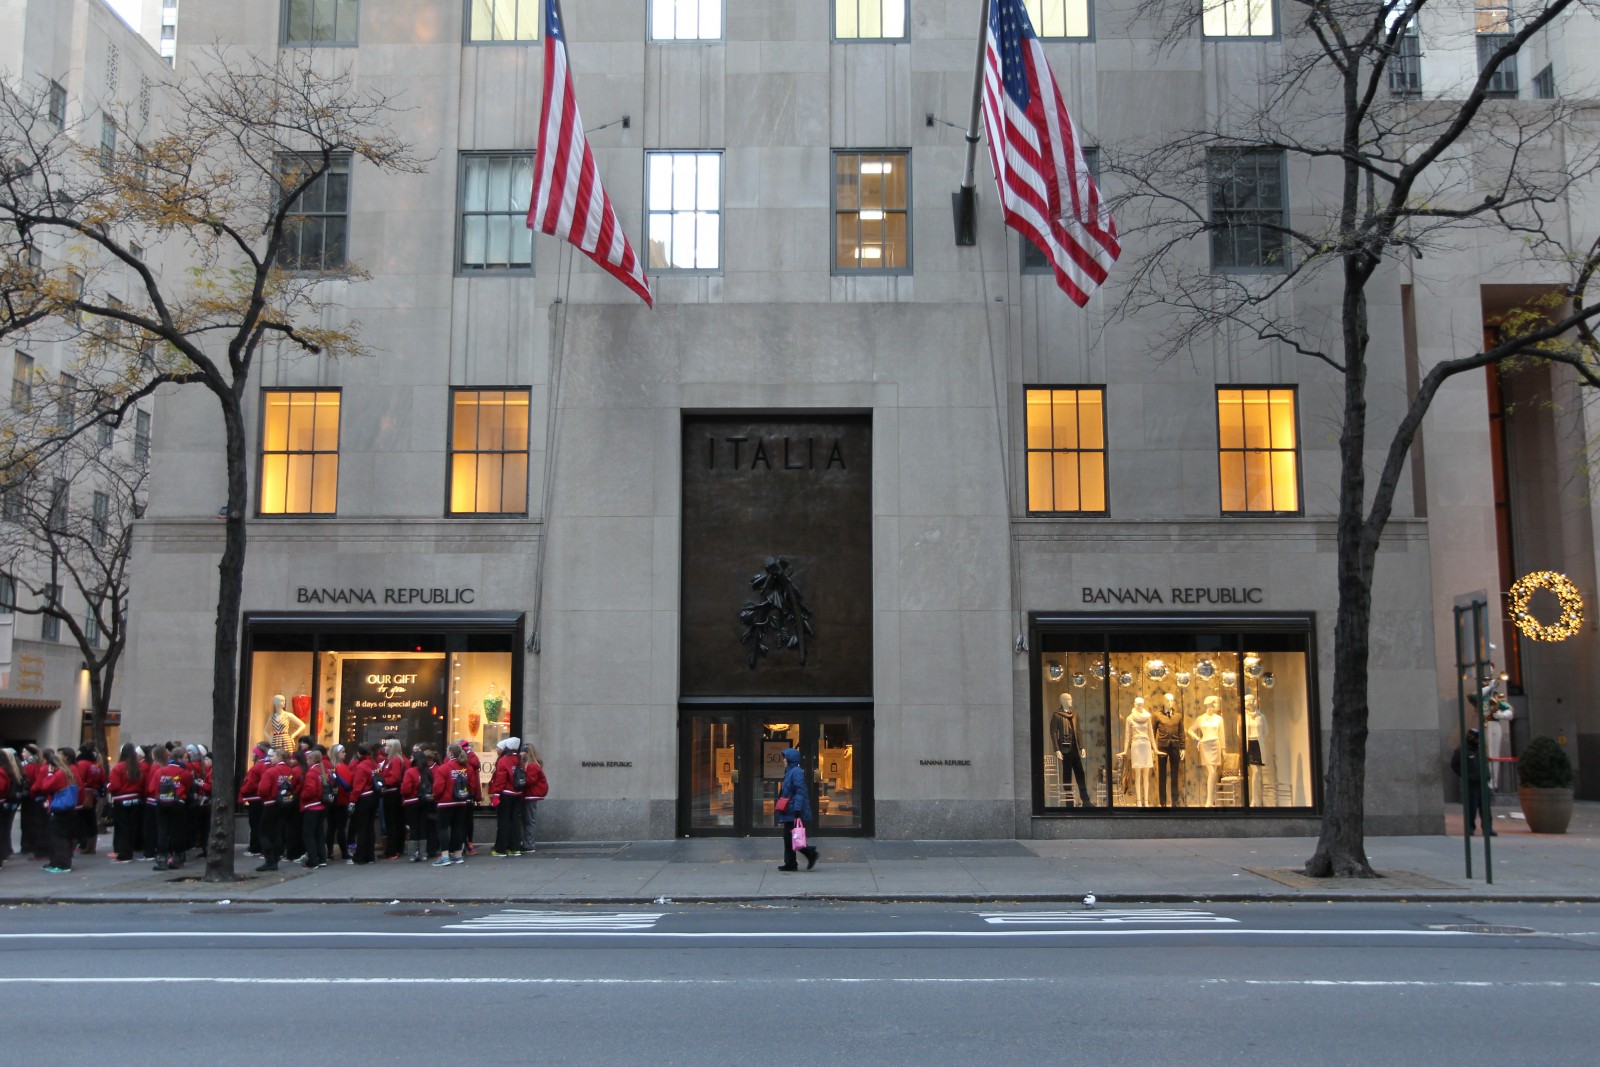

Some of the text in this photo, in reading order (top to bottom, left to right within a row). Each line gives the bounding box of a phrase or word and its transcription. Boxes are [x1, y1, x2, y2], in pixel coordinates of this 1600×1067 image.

[709, 437, 847, 470] ITALIA
[297, 587, 476, 604] BANANA REPUBLIC
[1081, 587, 1263, 604] BANANA REPUBLIC
[367, 674, 418, 684] OUR GIFT
[376, 684, 407, 699] to you
[362, 700, 378, 709] days
[387, 700, 411, 709] special
